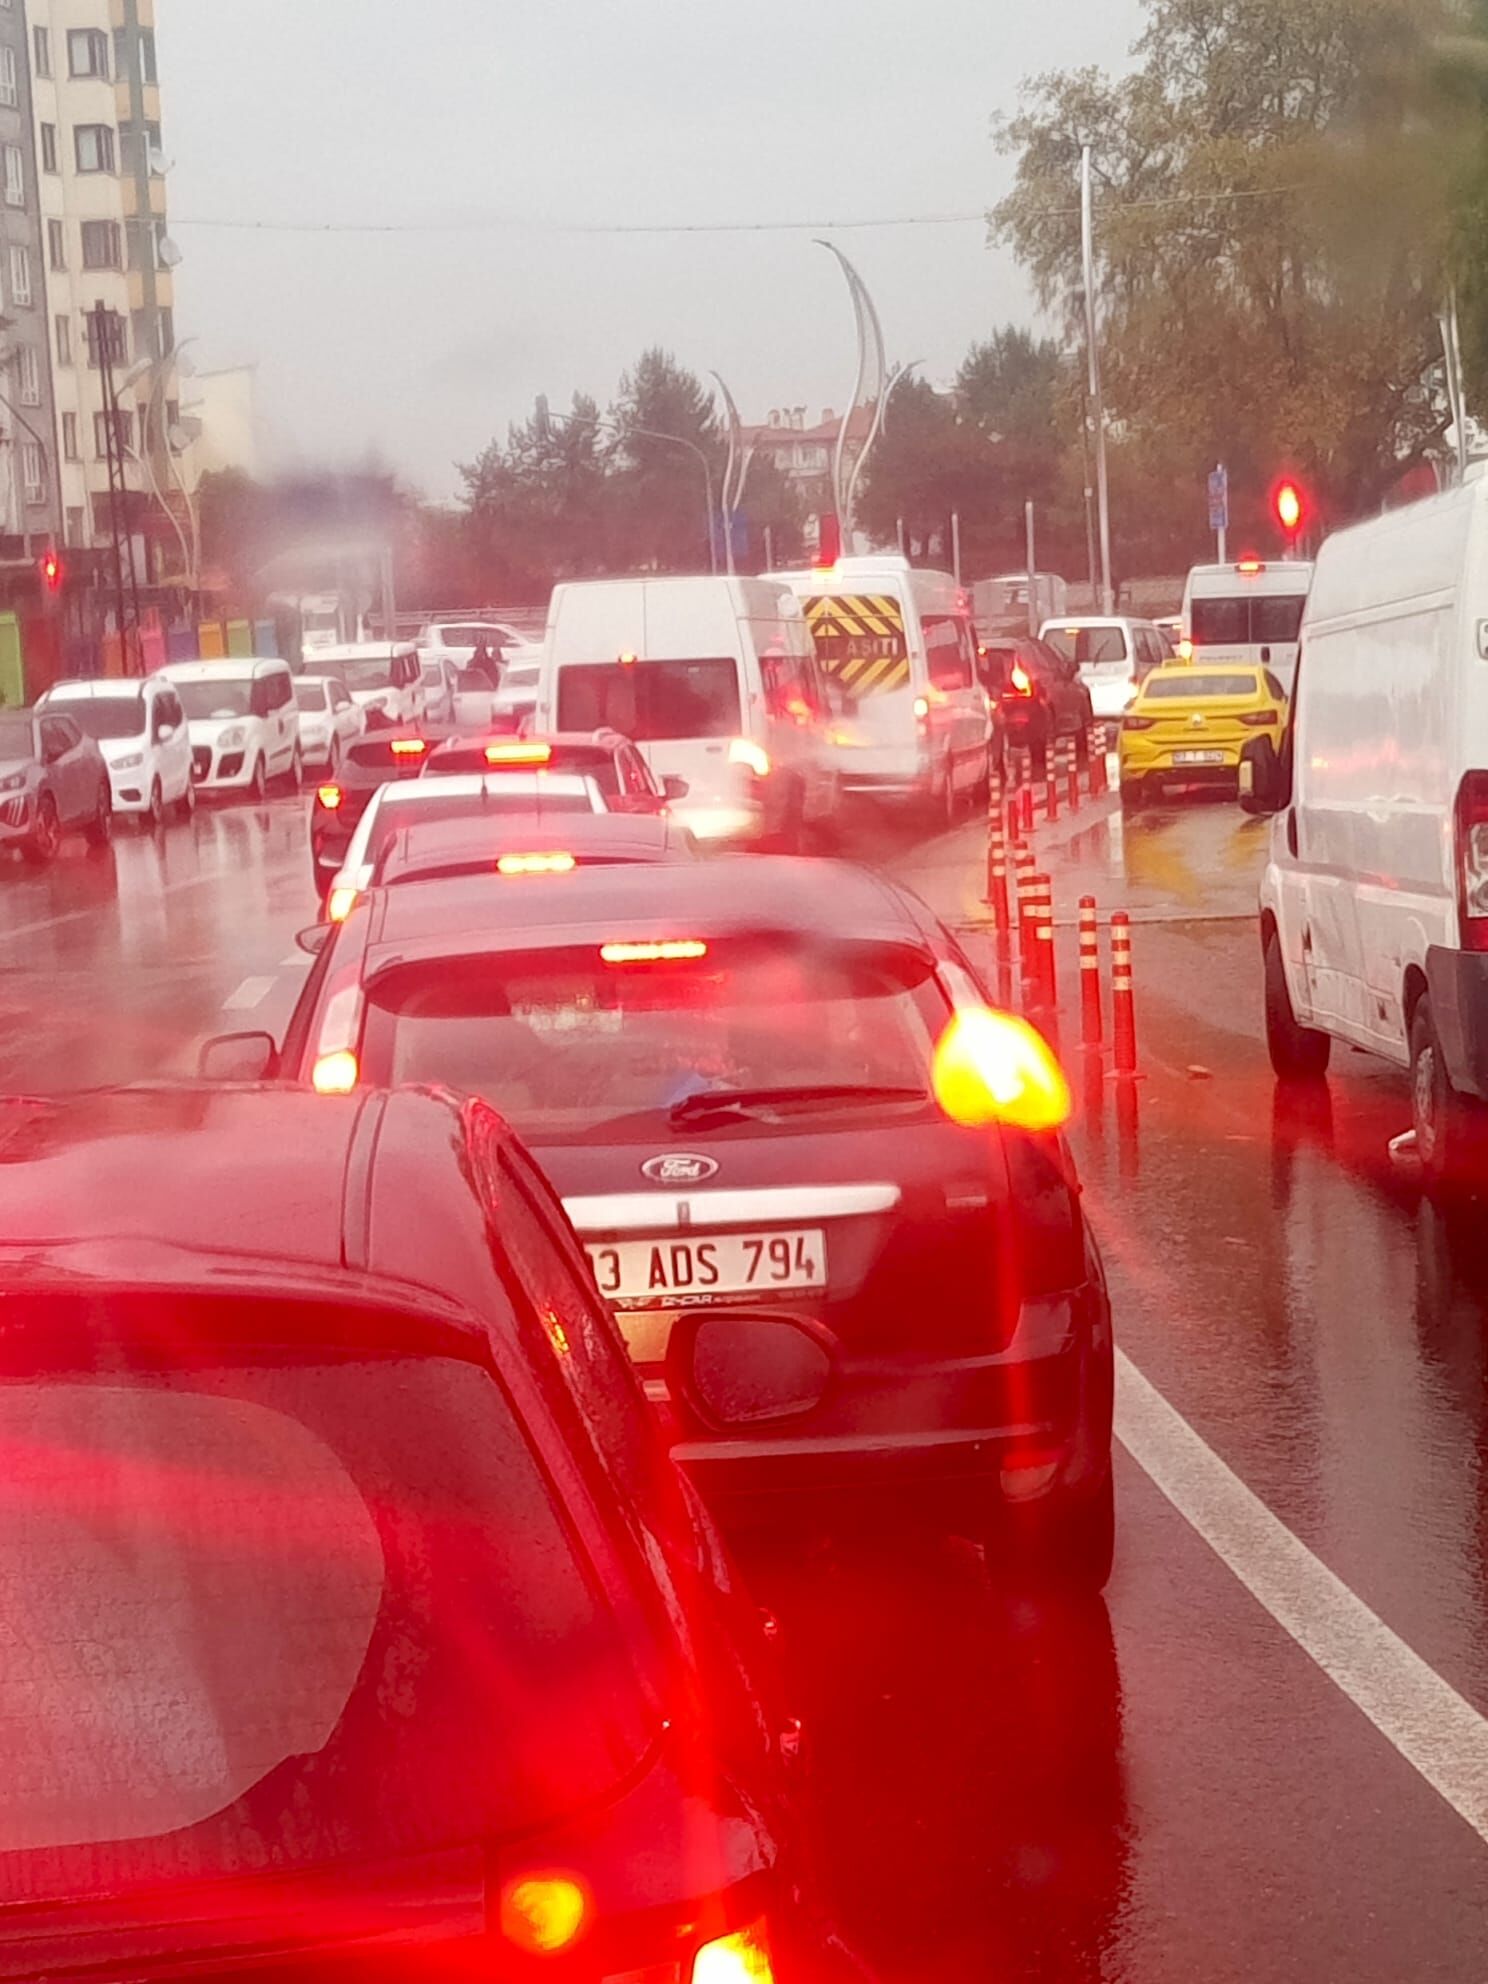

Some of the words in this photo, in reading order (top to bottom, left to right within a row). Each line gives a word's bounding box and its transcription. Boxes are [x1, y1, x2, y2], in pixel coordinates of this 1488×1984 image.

[660, 1159, 700, 1177] Ford
[599, 1249, 621, 1291] 3
[649, 1244, 719, 1289] ADS
[742, 1237, 815, 1283] 794
